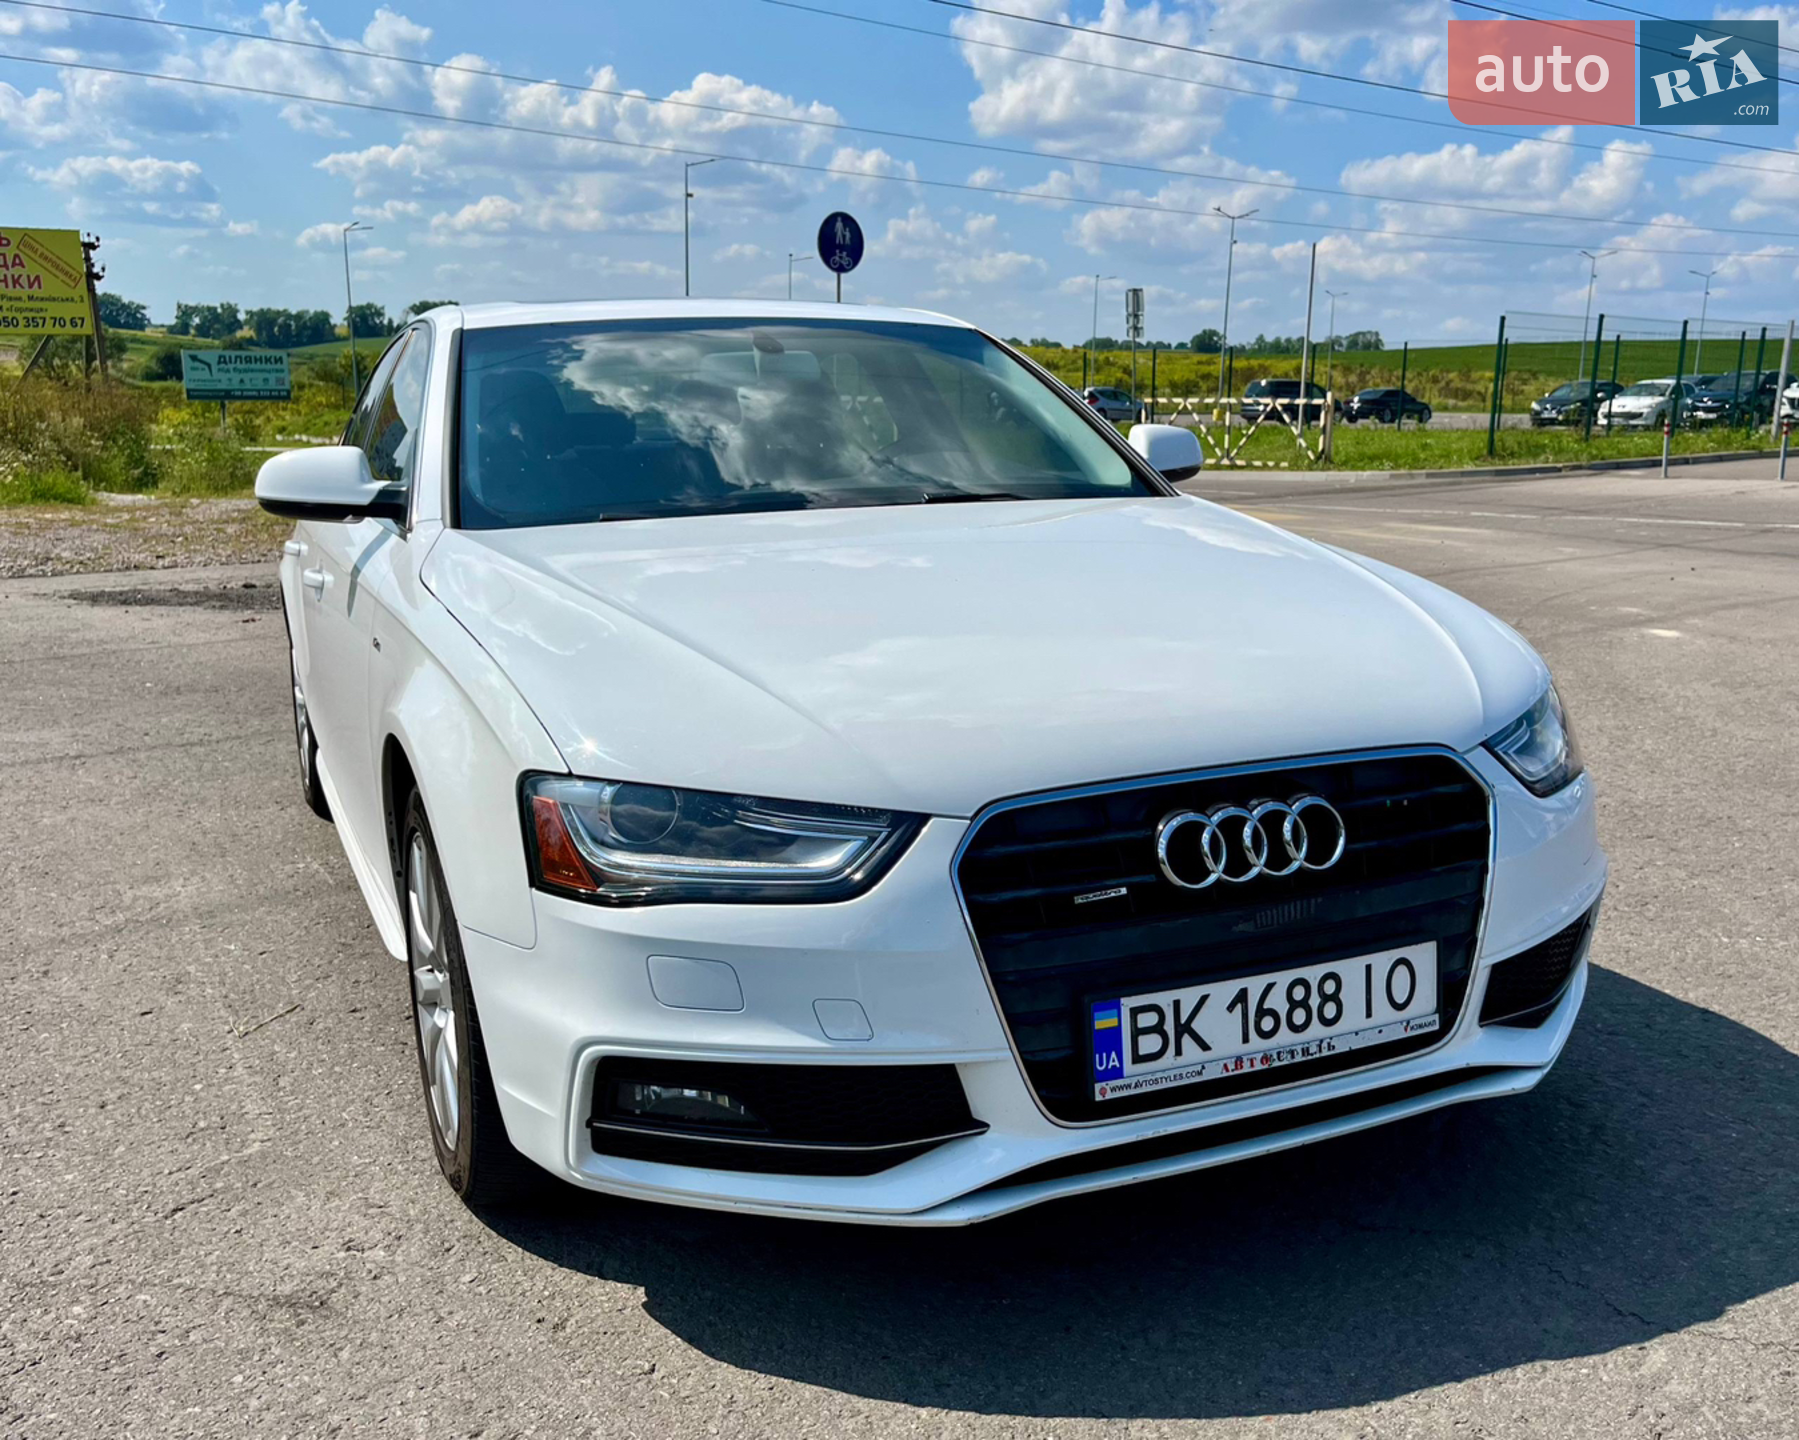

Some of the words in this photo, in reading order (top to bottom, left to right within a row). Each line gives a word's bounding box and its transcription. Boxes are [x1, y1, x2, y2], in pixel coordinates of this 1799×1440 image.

[38, 251, 78, 283] ВИРОБНИКА
[0, 316, 19, 328] 50
[23, 316, 46, 328] 357
[50, 316, 66, 328] 70
[70, 316, 85, 328] 67
[217, 354, 284, 366] ДІЛЯНКИ
[1129, 993, 1213, 1066] BK
[1226, 971, 1343, 1045] 1688
[1095, 1050, 1120, 1071] UA
[1109, 1069, 1204, 1093] WWW.AVTOSTYLES.COM
